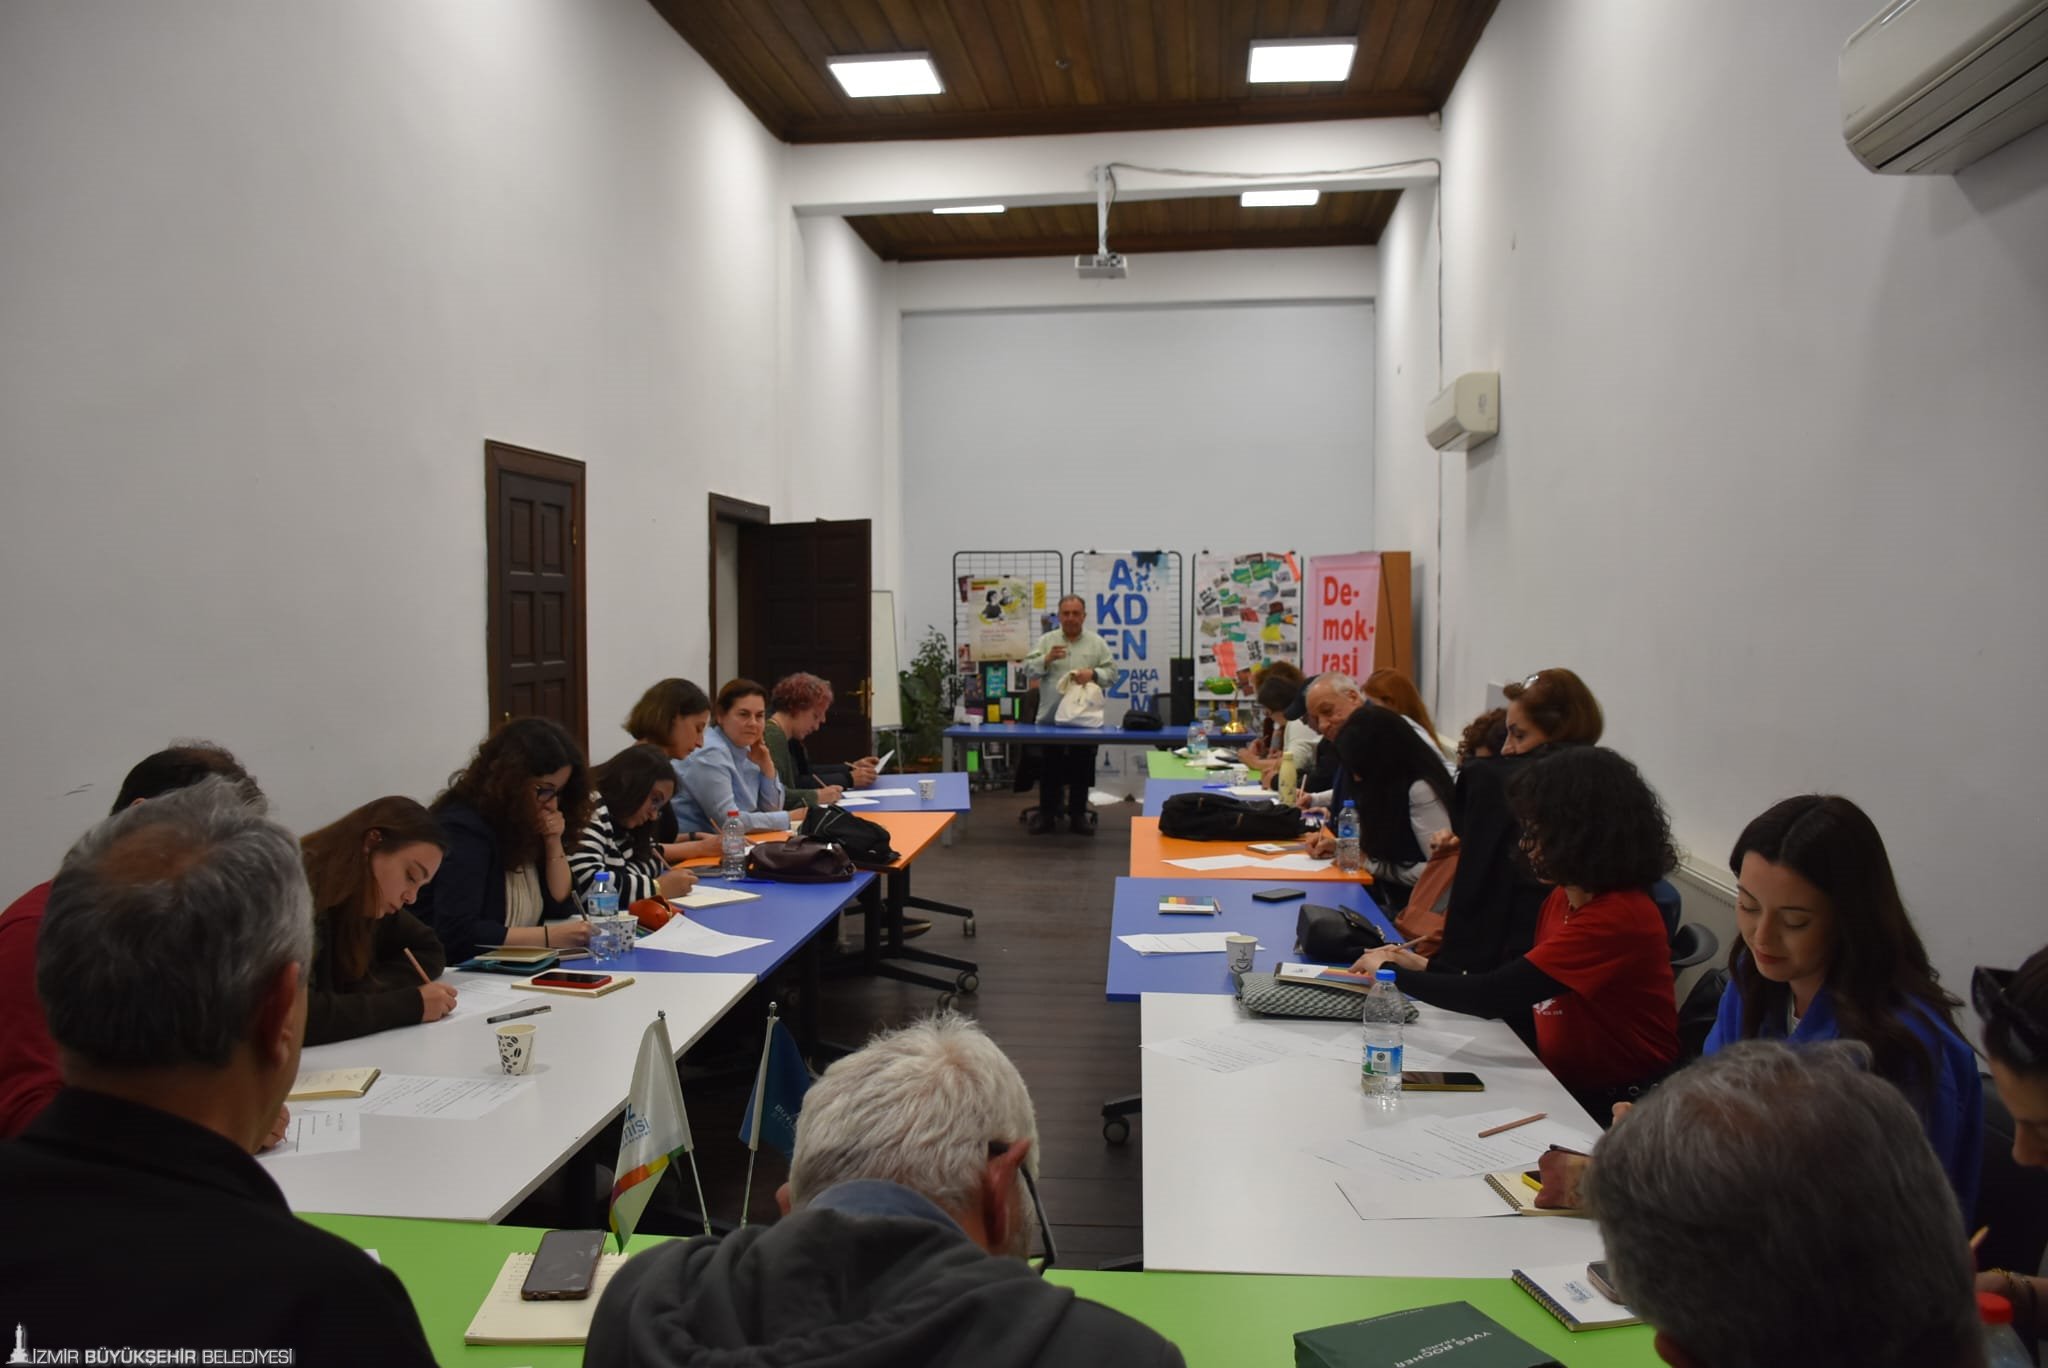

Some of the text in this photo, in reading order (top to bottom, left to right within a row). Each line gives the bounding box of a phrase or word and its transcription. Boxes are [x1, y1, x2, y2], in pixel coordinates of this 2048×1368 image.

[1096, 593, 1149, 626] KD
[1130, 669, 1159, 681] AKA
[1321, 646, 1359, 677] rasi
[1130, 682, 1148, 694] DE
[1394, 1331, 1492, 1368] YVES ROCHER
